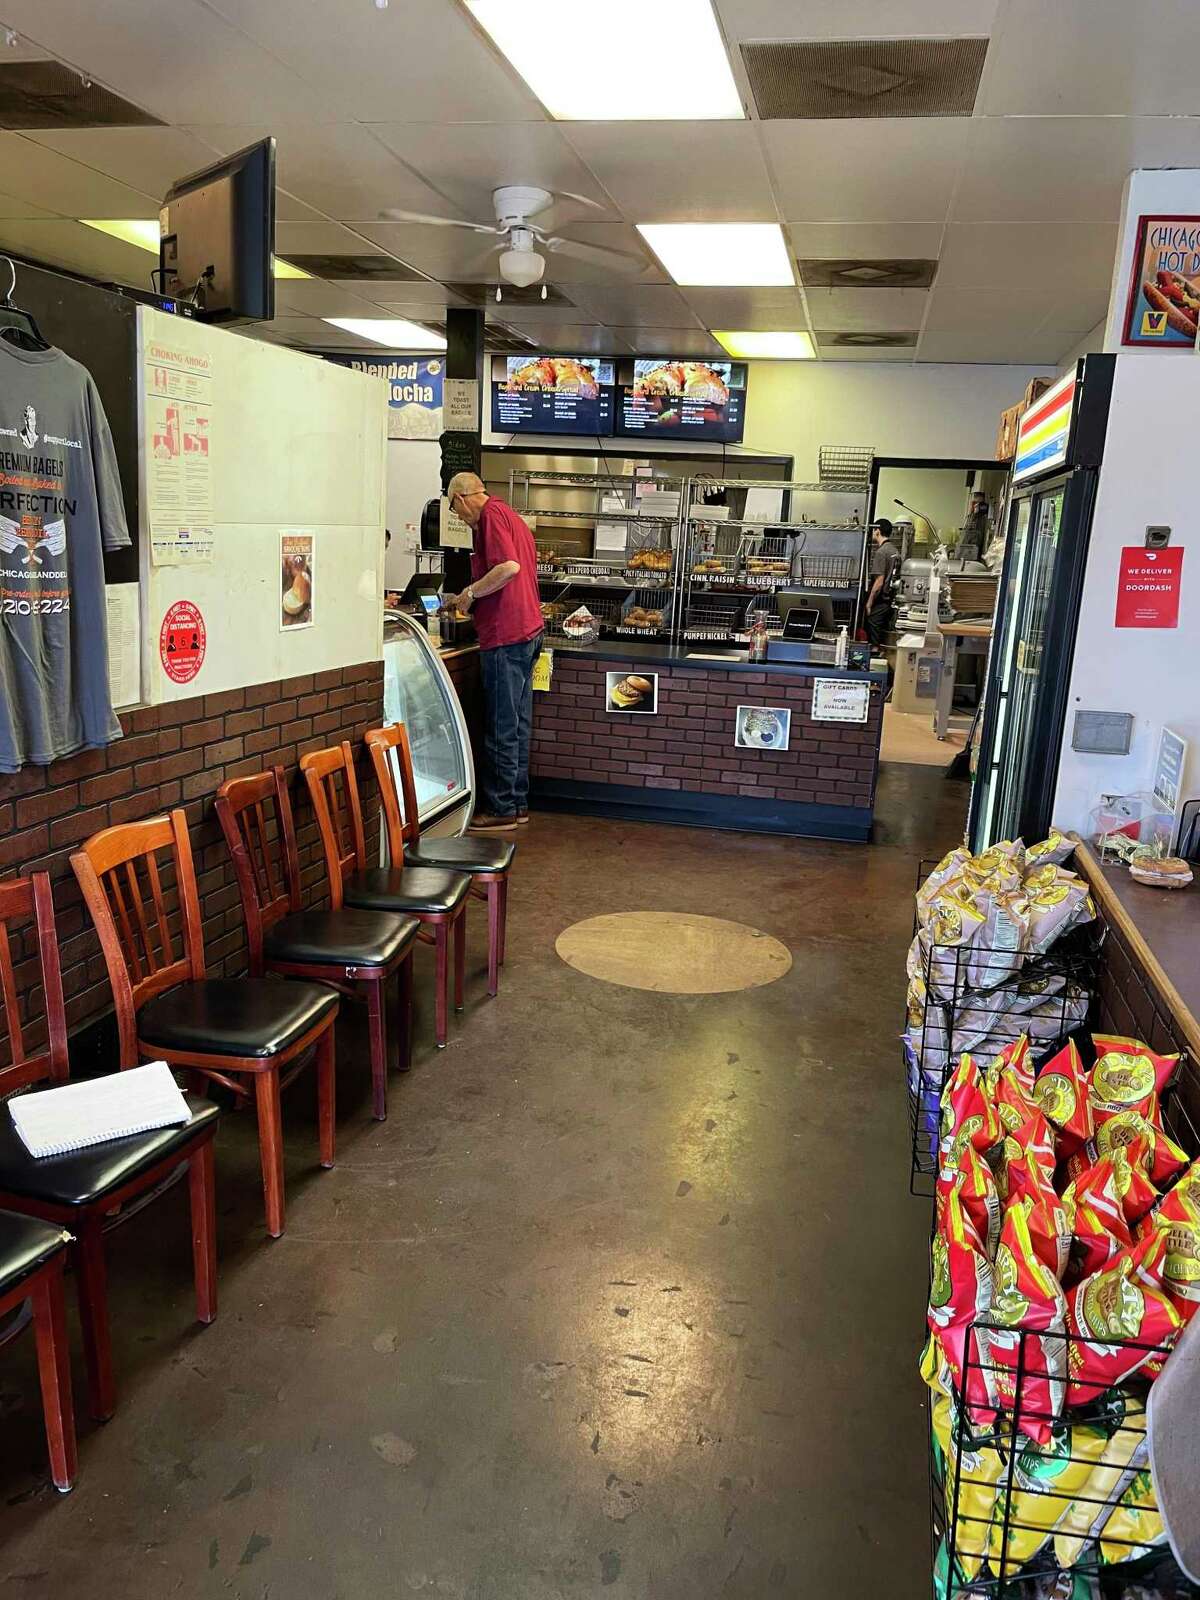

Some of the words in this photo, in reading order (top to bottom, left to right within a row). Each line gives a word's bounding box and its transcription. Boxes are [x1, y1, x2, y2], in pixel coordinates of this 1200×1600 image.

[1158, 251, 1187, 273] HOT
[151, 347, 183, 363] CHOKING
[351, 361, 418, 380] Blended
[33, 456, 64, 478] BAGELS
[709, 575, 735, 585] RAISIN
[747, 577, 792, 588] BLUEBERRY
[1126, 584, 1172, 592] DOORDASH
